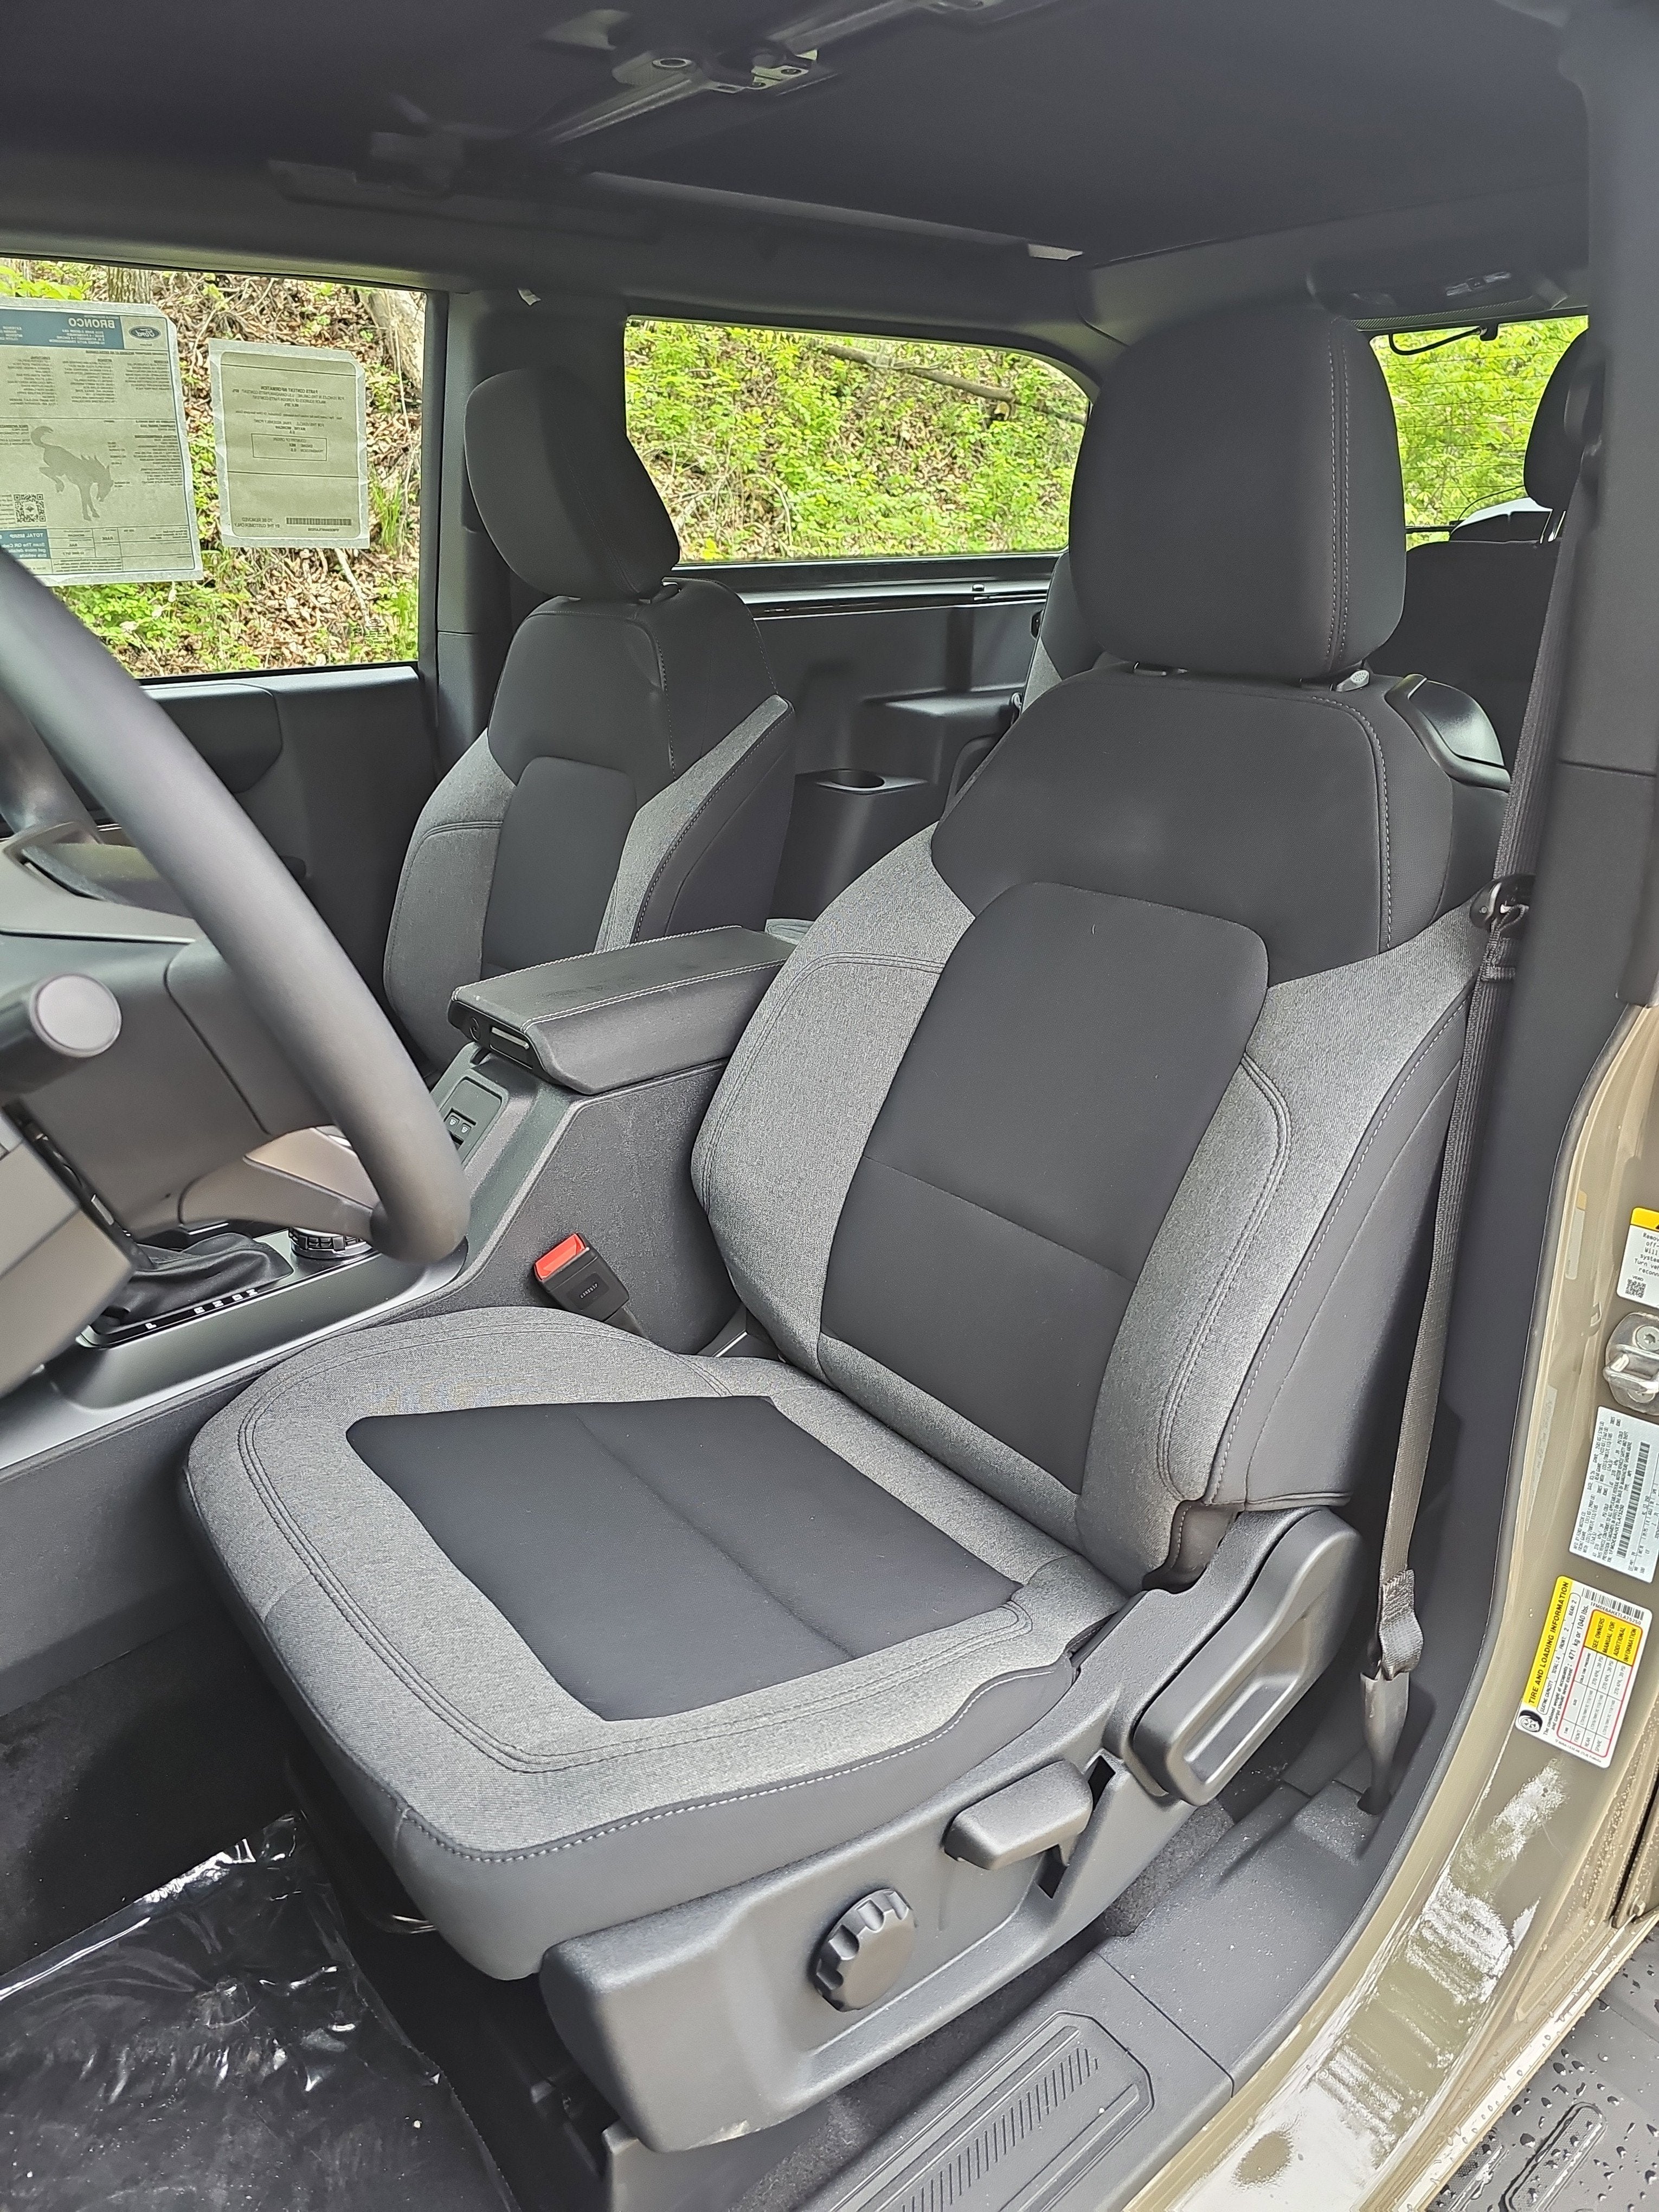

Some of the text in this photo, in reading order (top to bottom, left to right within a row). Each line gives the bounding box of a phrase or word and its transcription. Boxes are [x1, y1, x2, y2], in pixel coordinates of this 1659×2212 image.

[1644, 1247, 1658, 1256] Will
[1634, 1258, 1648, 1266] Turn
[1580, 1603, 1589, 1615] lbs.
[1576, 1614, 1586, 1630] 1040
[1574, 1630, 1581, 1638] or
[1602, 1620, 1616, 1654] MANUAL FOR
[1612, 1625, 1626, 1657] ADDITIONAL
[1527, 1580, 1570, 1706] TIRE AND LOADING INFORMATION
[1571, 1637, 1580, 1647] kg
[1622, 1627, 1637, 1662] INFORMATION
[1567, 1648, 1576, 1661] 471
[1565, 1667, 1573, 1683] exceed
[1546, 1706, 1555, 1727] combined
[1552, 1692, 1560, 1707] weight
[1558, 1665, 1568, 1687] occupants
[1594, 1739, 1602, 1752] SPARE
